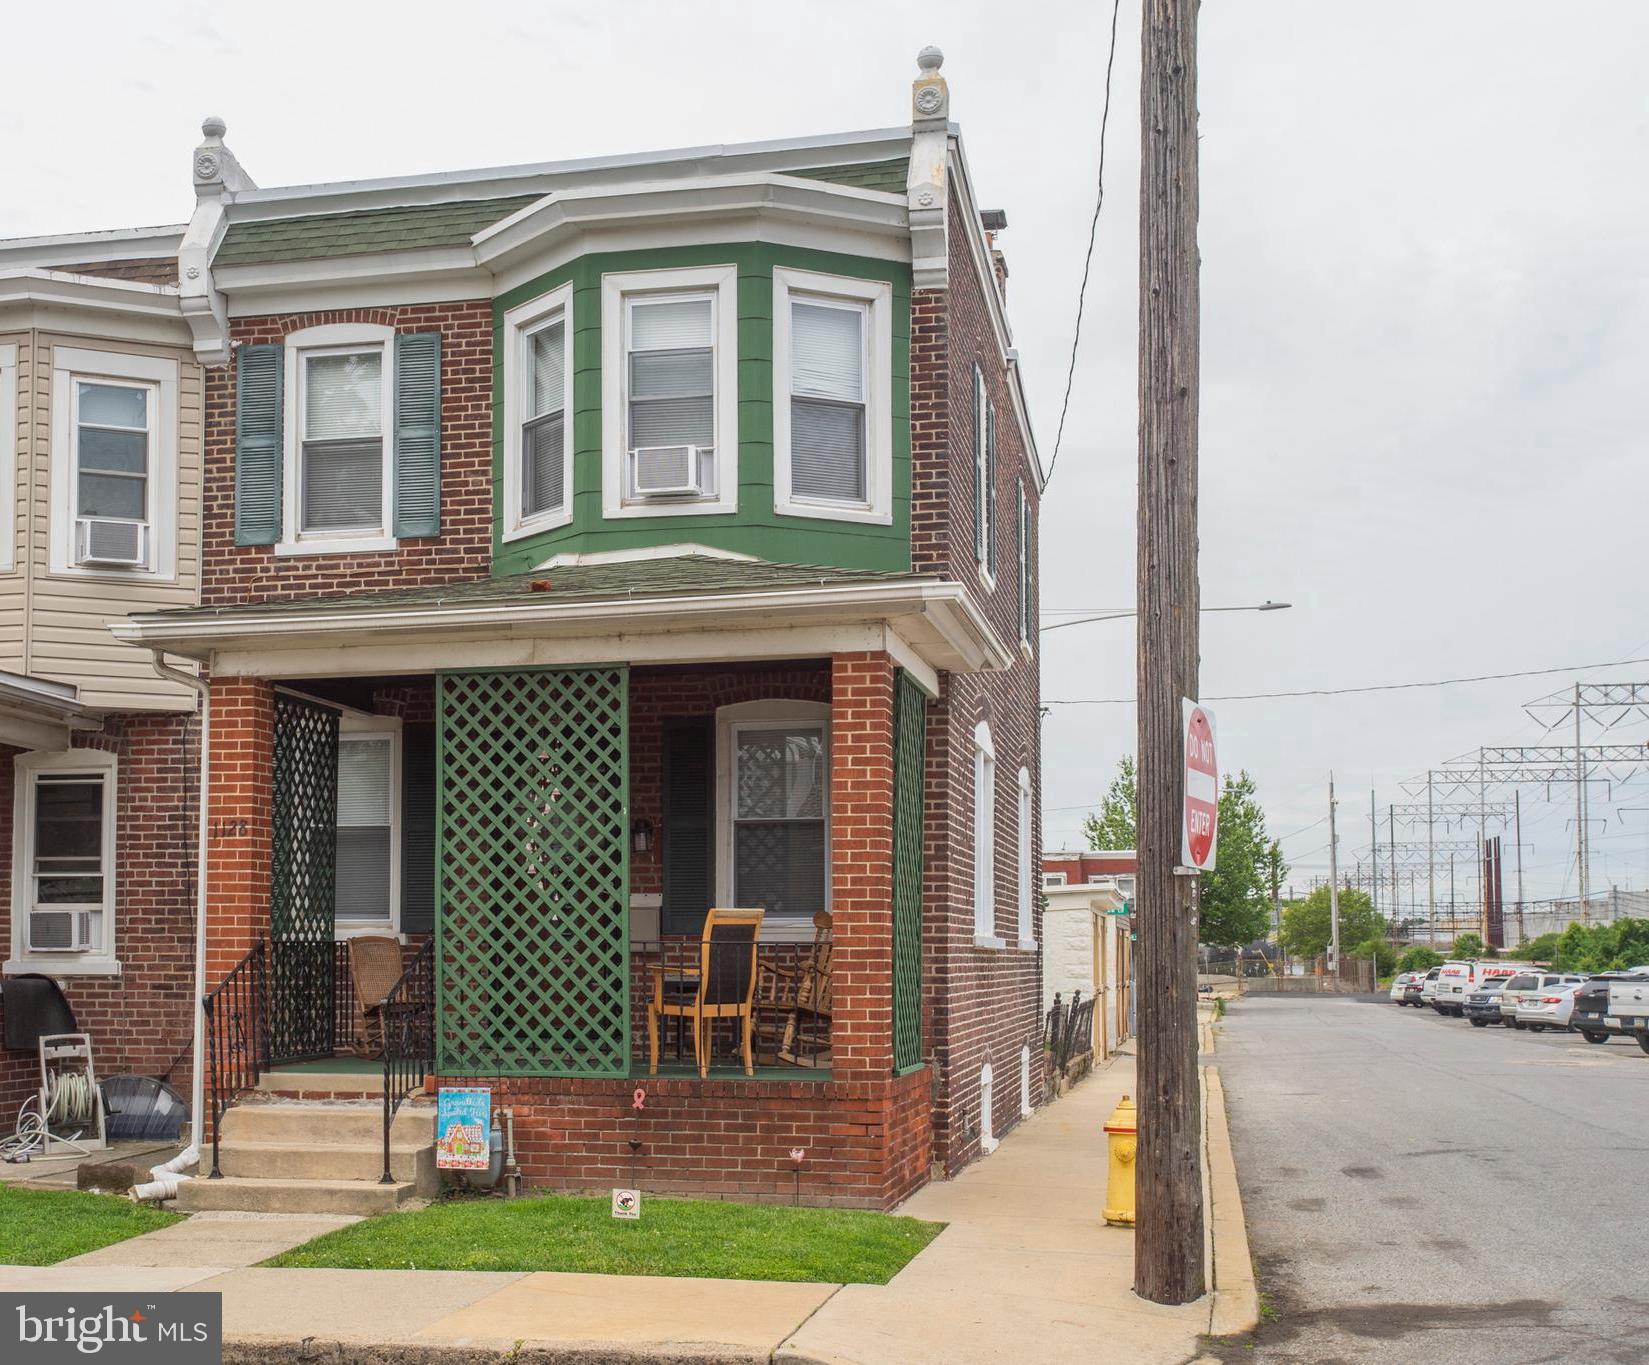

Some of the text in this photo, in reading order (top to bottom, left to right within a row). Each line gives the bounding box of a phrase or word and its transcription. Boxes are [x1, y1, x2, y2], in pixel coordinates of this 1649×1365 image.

[1189, 734, 1213, 765] DO NOT
[213, 819, 248, 840] 1128
[1190, 809, 1210, 837] ENTER
